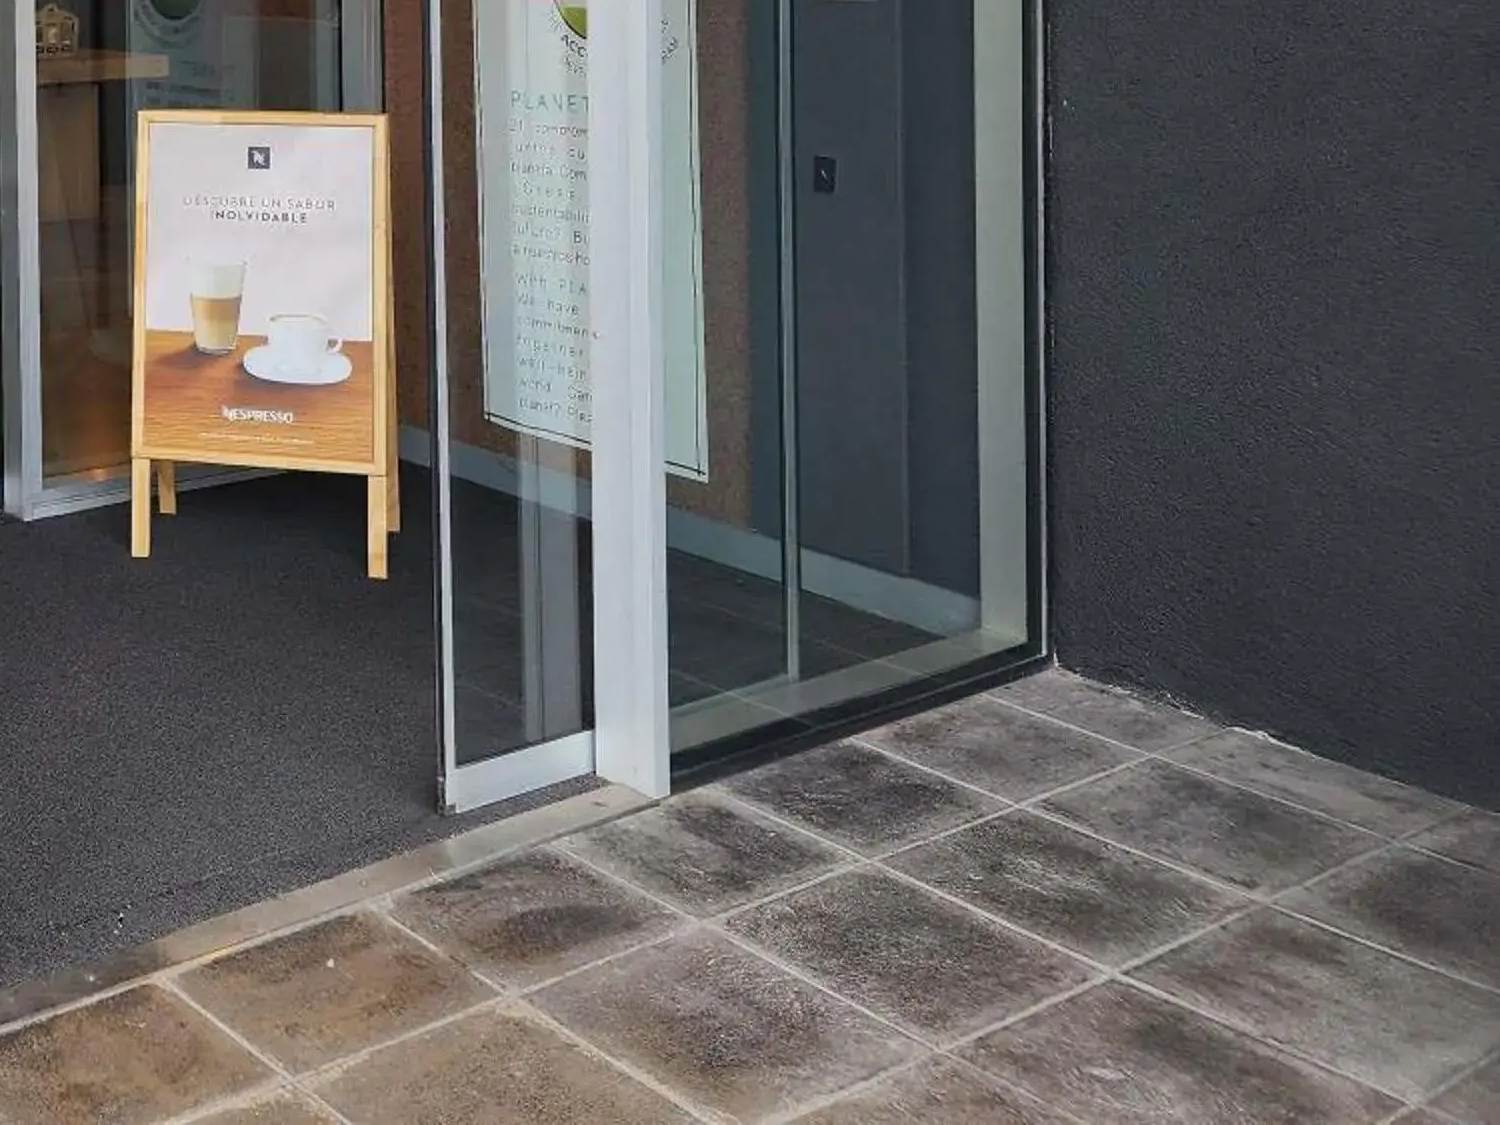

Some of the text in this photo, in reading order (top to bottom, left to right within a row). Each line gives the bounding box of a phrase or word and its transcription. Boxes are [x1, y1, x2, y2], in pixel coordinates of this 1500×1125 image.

[183, 194, 335, 211] DESCUBRE UN SABOR
[211, 210, 307, 223] INOLVIDABLE
[221, 405, 293, 424] NESPRESSO
